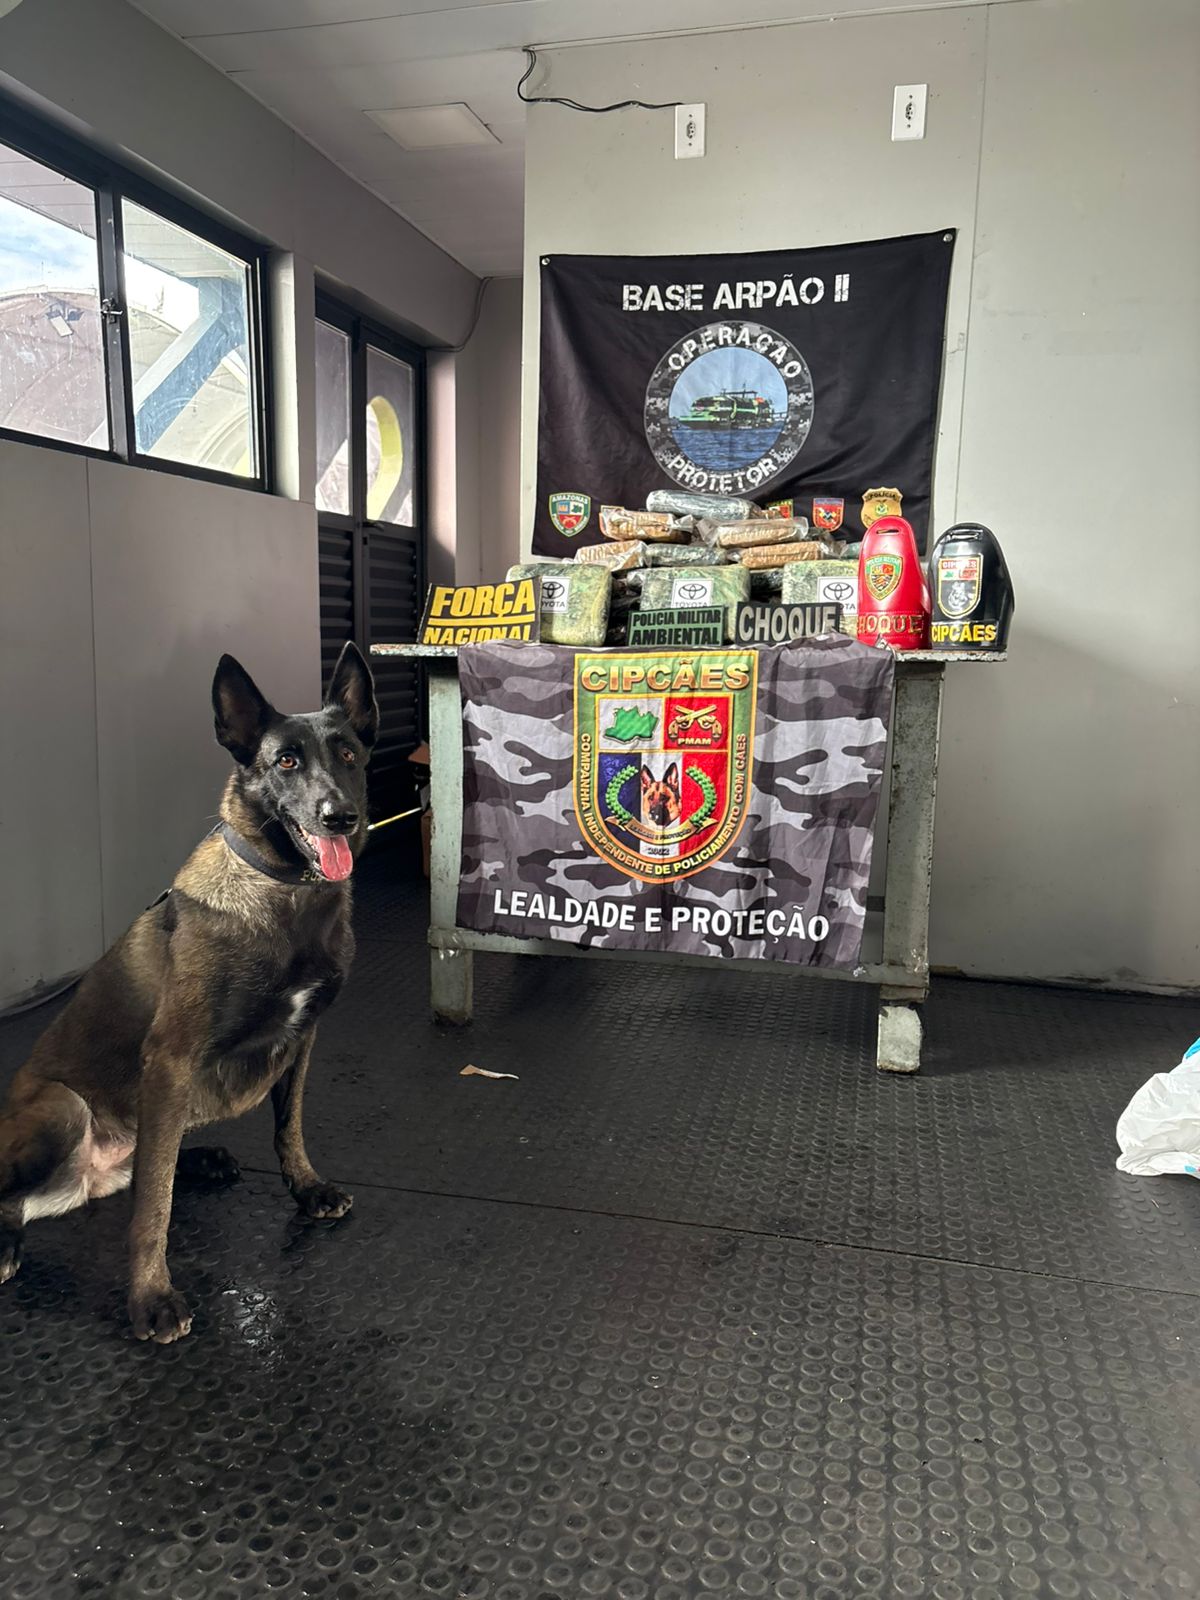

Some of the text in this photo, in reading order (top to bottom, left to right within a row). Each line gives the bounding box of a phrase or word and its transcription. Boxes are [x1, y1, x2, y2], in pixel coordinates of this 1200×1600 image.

[622, 273, 850, 312] BASE ARPÃO II
[667, 326, 802, 379] OPERAÇÃO
[667, 455, 778, 493] PROTETOR
[552, 494, 588, 505] AMAZONAS
[430, 579, 536, 618] FORÇA
[677, 609, 722, 625] MILITAR
[631, 627, 720, 646] AMBIENTAL
[738, 606, 836, 642] CHOQUE
[581, 659, 750, 692] CIPCÃES
[677, 737, 711, 745] PMAM
[580, 733, 591, 812] COMPANHIA
[734, 774, 744, 803] COM
[583, 813, 653, 874] INDEPENDENTE
[674, 808, 740, 874] POLICIAMENTO
[655, 864, 671, 875] DE
[492, 889, 829, 943] LEALDADE E PROTEÇÃO
